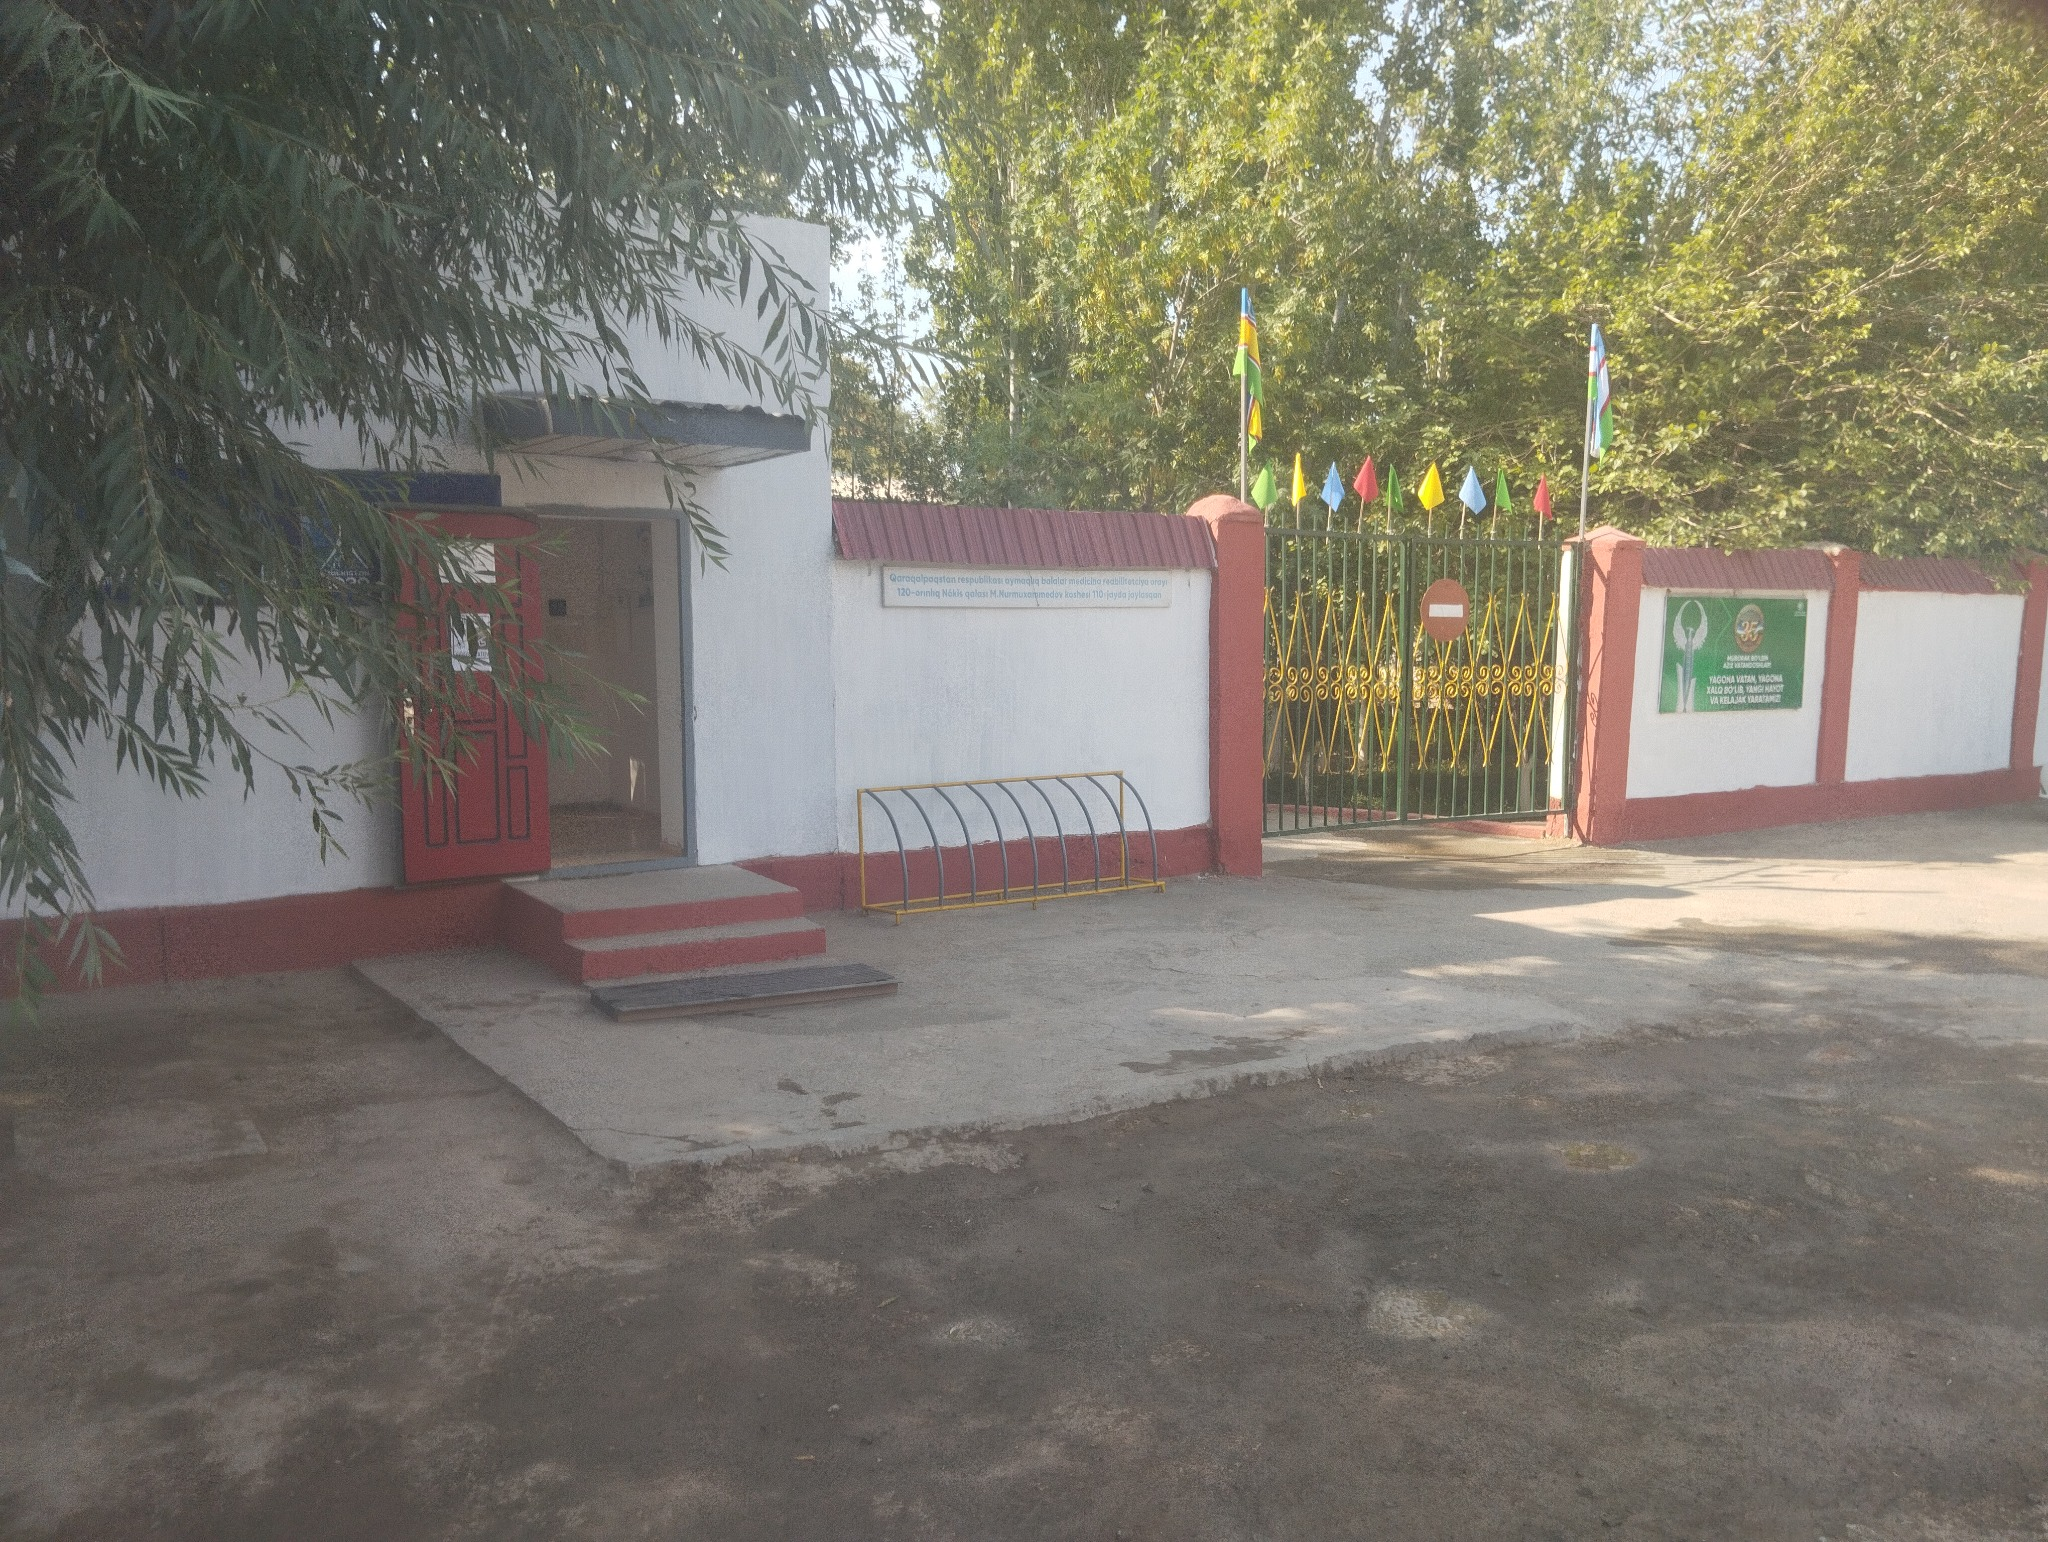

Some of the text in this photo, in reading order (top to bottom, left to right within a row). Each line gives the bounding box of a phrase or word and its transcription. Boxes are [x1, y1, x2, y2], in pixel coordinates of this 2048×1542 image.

[1709, 673, 1783, 684] YAGONA VATAN, YAGONA
[1706, 685, 1723, 695] XALQ
[1709, 696, 1719, 705] VA
[1719, 695, 1747, 704] KELAJAK
